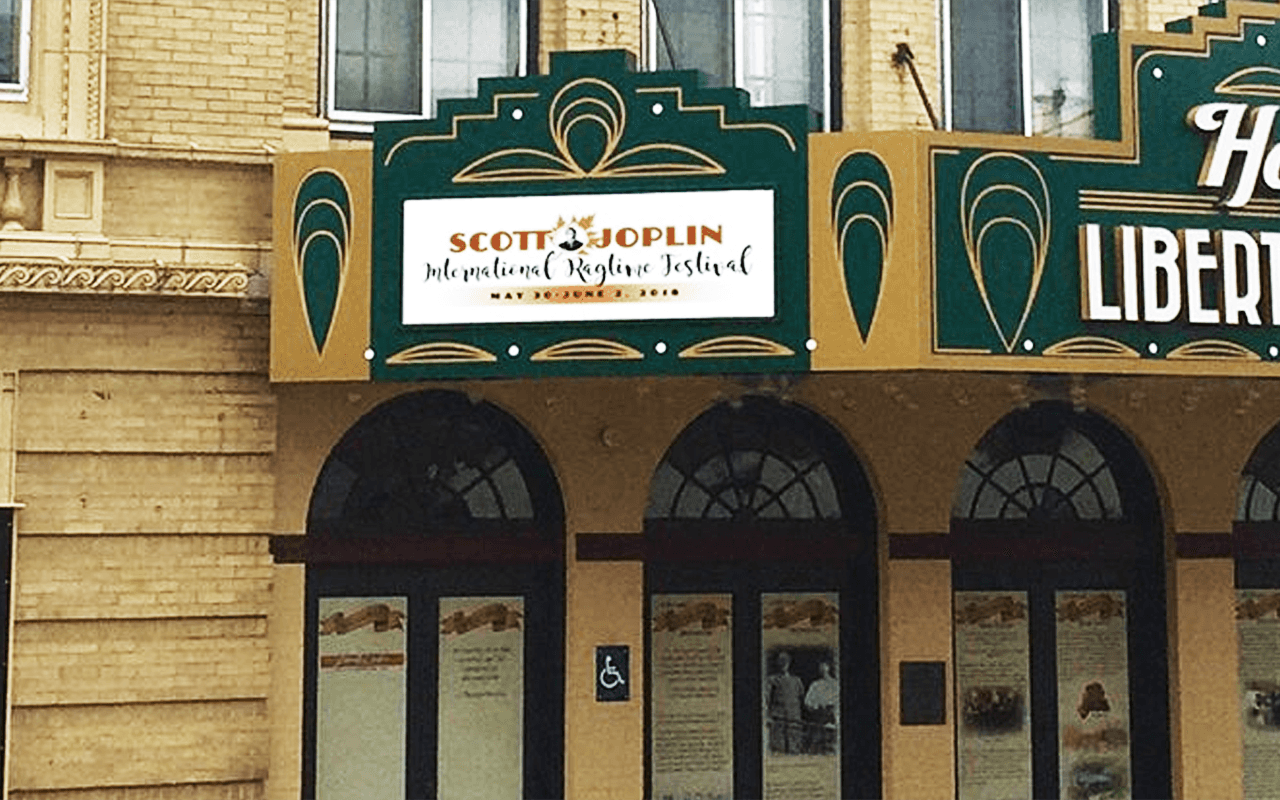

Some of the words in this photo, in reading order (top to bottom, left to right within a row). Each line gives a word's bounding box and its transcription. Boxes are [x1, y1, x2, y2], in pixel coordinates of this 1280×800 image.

[449, 230, 552, 253] SCOTT
[595, 224, 723, 249] JOPLIN
[423, 250, 555, 284] International
[565, 252, 652, 288] Ragtime
[660, 244, 753, 278] Festival
[490, 291, 524, 301] MAY
